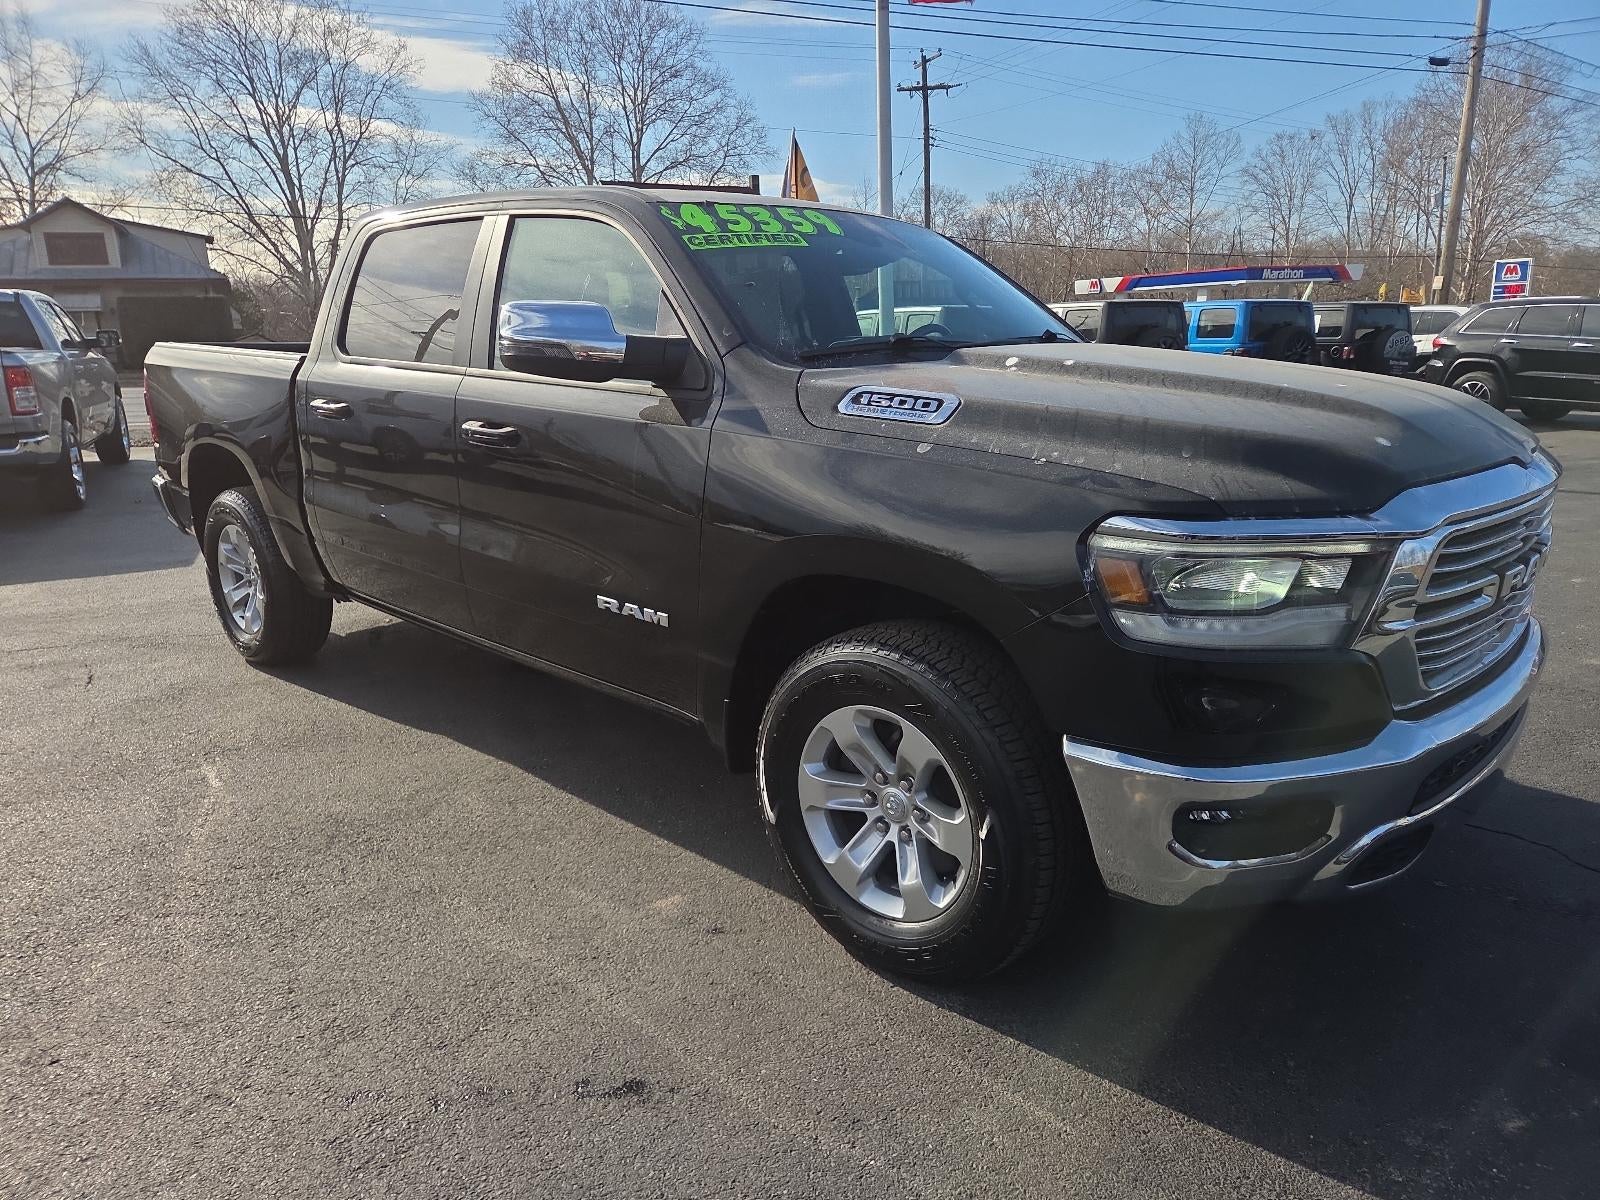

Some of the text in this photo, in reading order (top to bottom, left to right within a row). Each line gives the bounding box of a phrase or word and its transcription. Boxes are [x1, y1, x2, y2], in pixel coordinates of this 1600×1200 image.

[659, 203, 844, 237] $45359
[686, 232, 802, 248] CERTIFIED
[1262, 268, 1304, 280] Marathon
[1504, 264, 1519, 276] M
[852, 404, 879, 414] HEMI
[860, 393, 939, 412] 1500
[1500, 553, 1540, 598] RA
[596, 594, 669, 628] RAM
